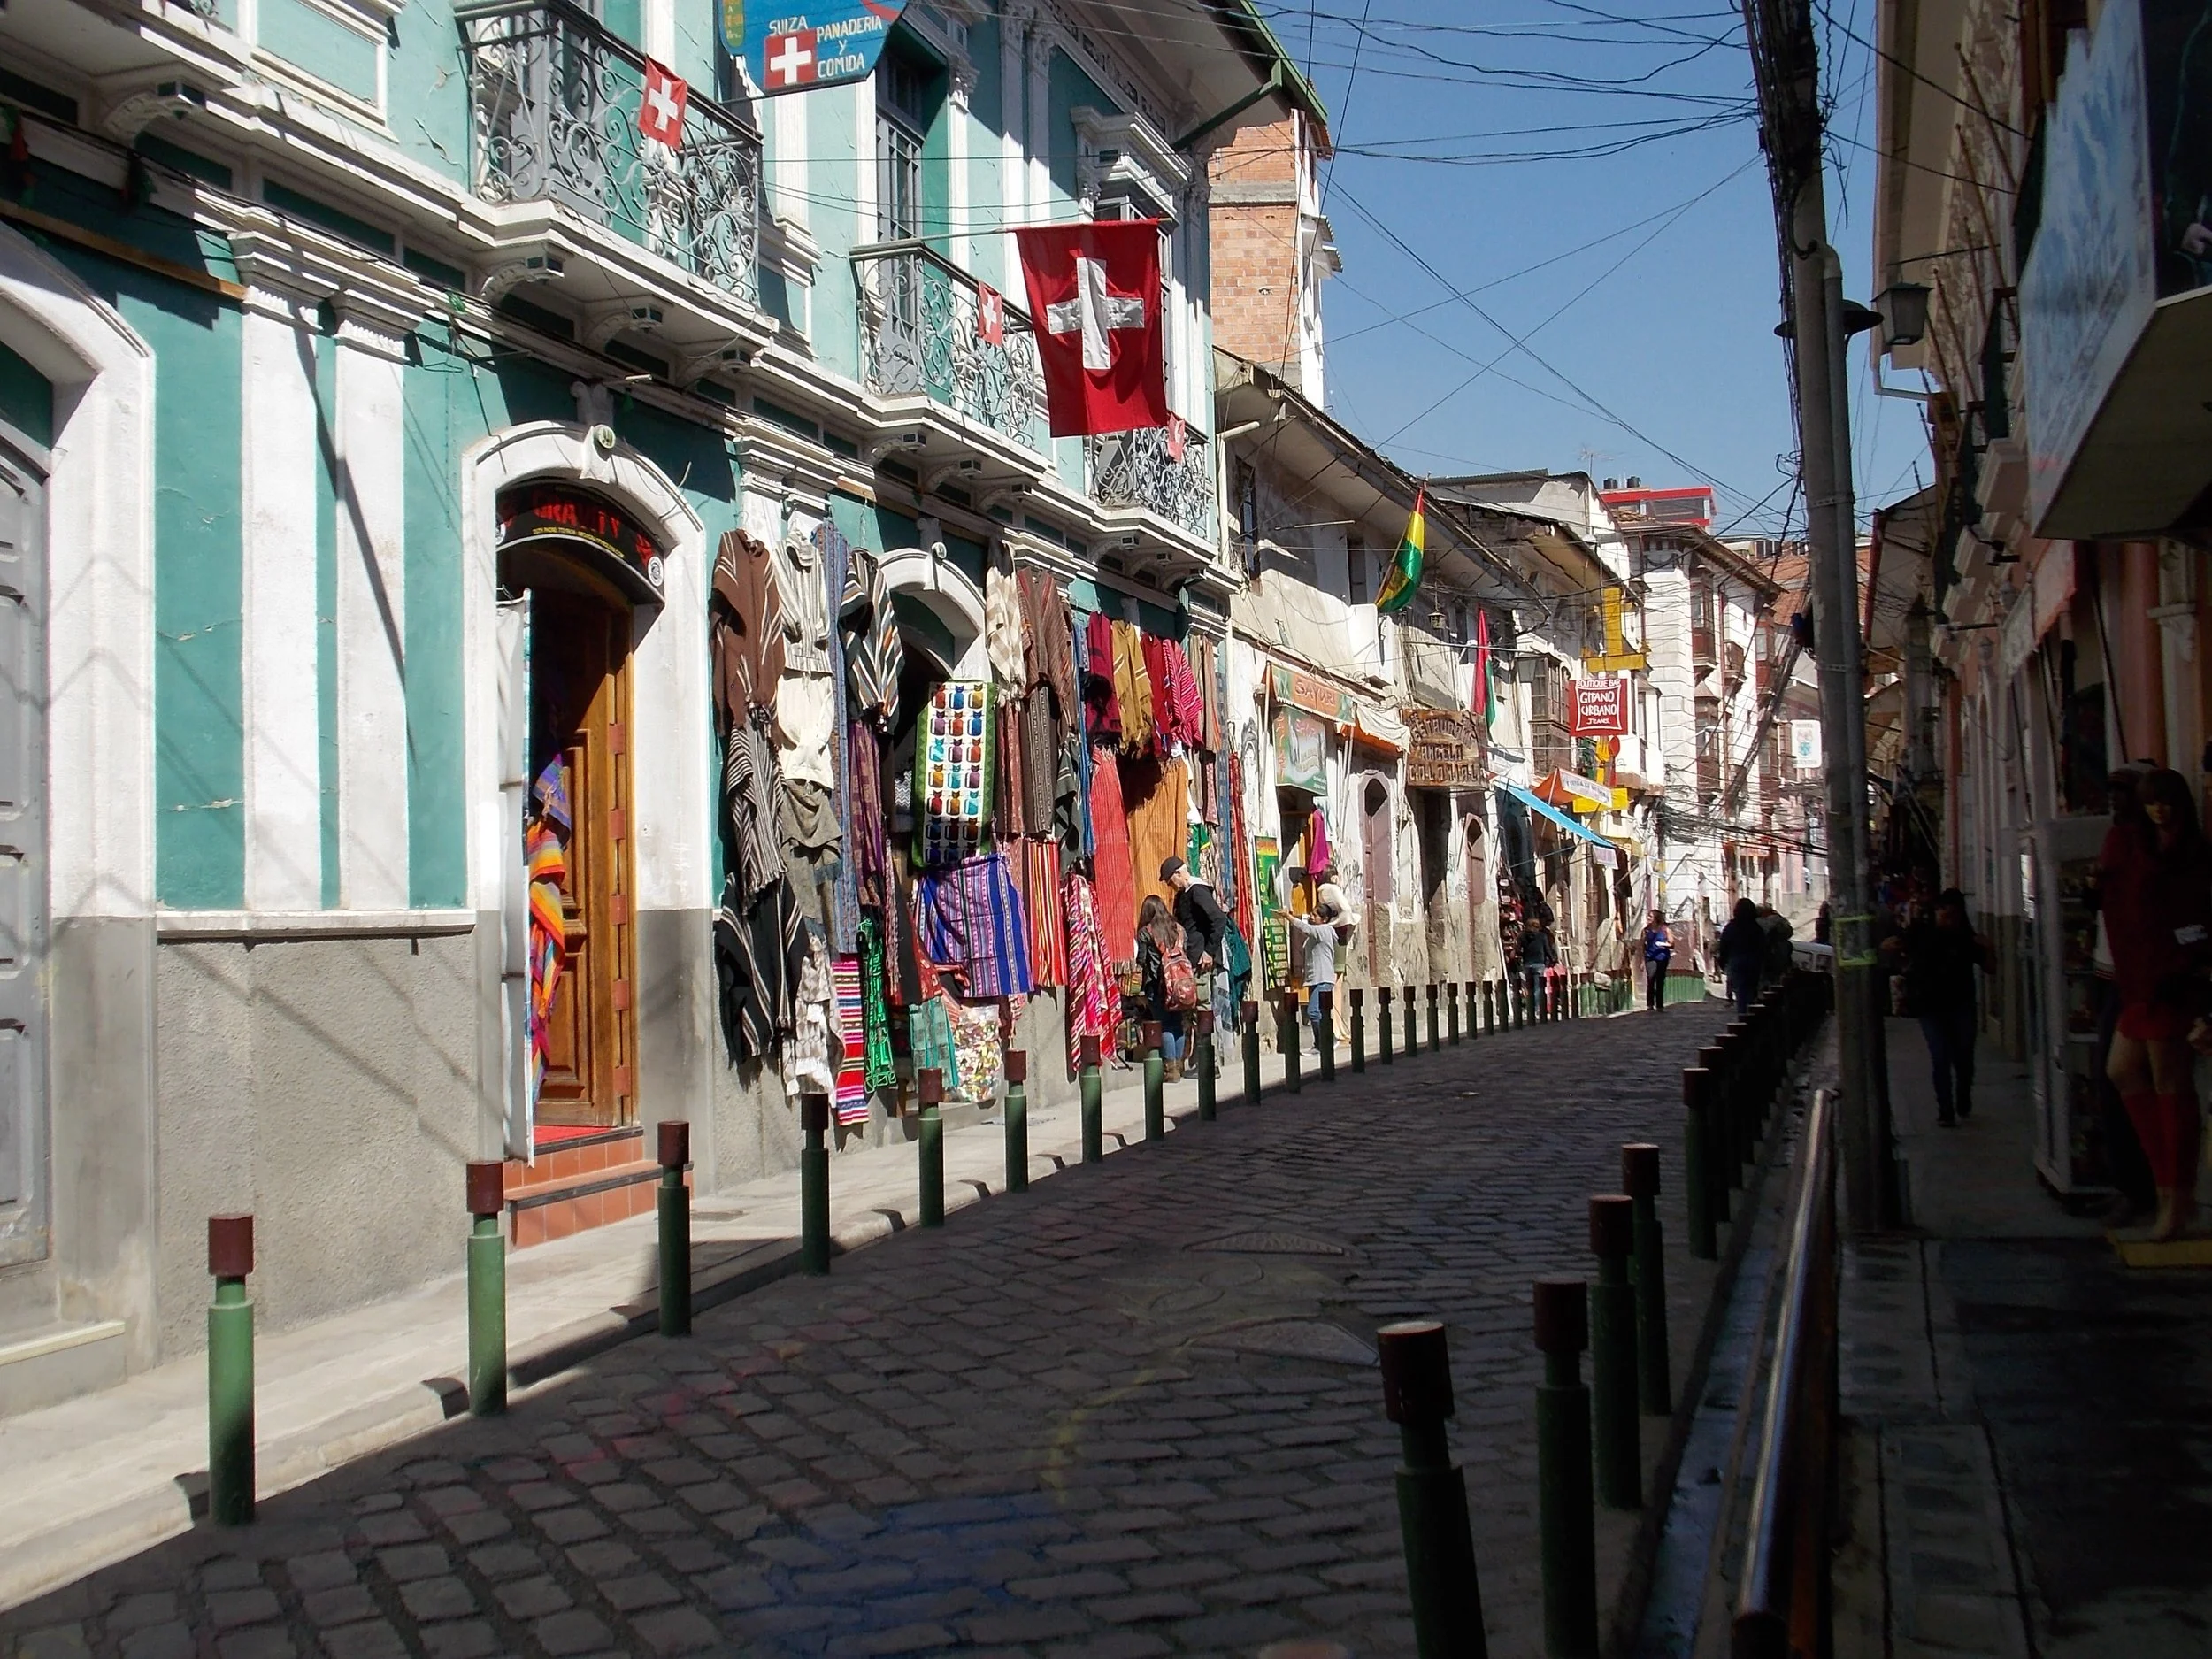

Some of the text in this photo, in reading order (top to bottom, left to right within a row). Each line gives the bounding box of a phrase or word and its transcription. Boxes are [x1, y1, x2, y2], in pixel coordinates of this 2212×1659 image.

[769, 15, 809, 36] SUIZA
[816, 14, 883, 43] PANADERIA
[818, 51, 865, 78] COMIDA
[1576, 679, 1608, 687] BOUTIQUE
[1579, 691, 1615, 703] GITANO
[1580, 704, 1617, 716] URBANO
[1263, 916, 1276, 990] ALPACA
